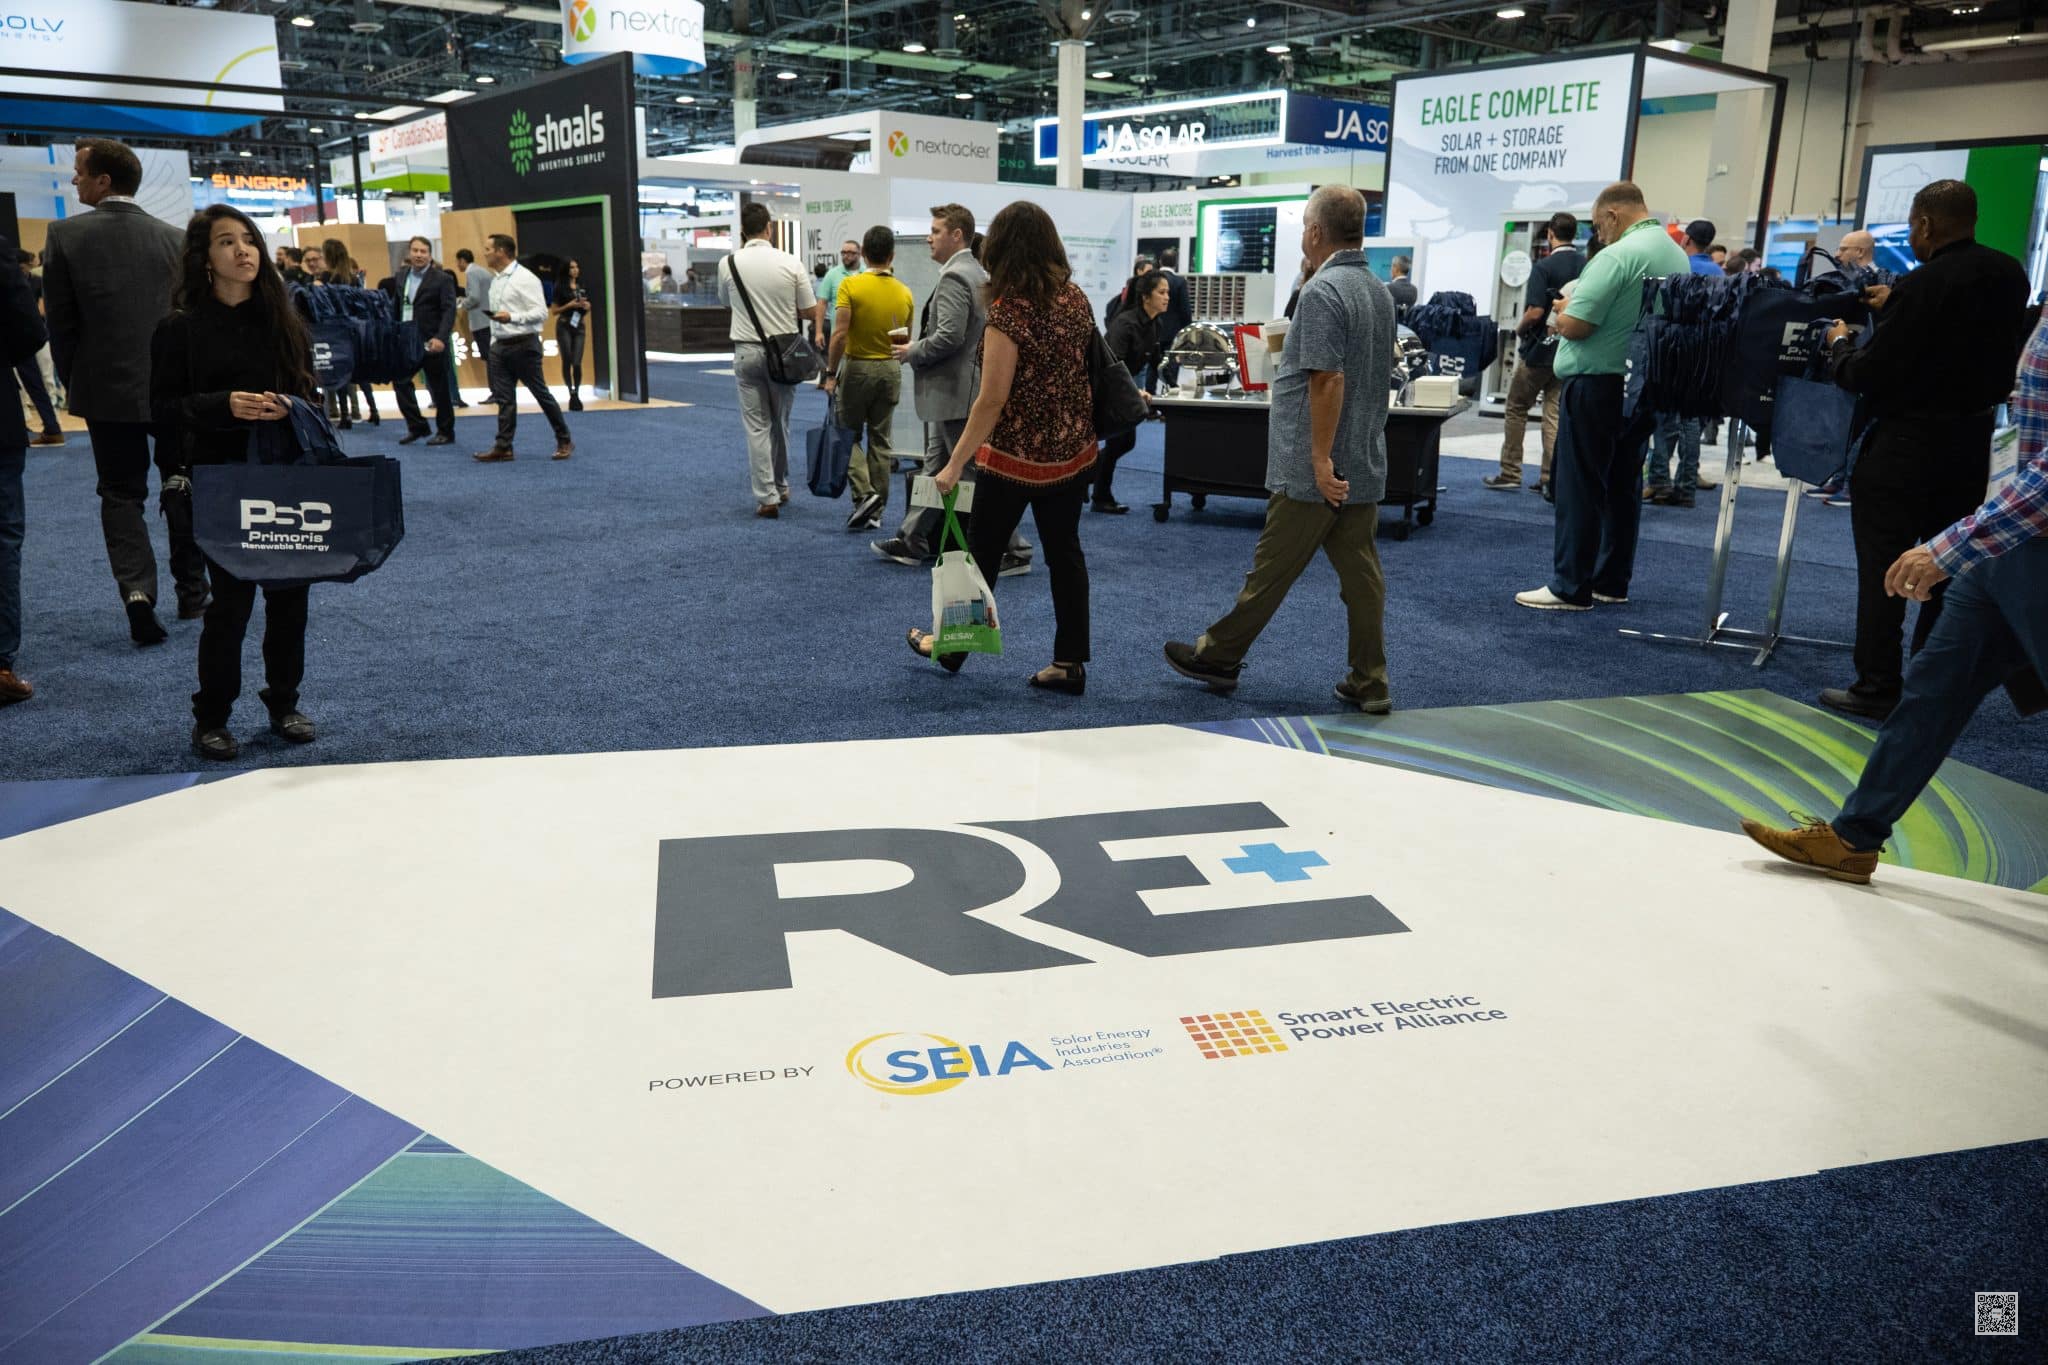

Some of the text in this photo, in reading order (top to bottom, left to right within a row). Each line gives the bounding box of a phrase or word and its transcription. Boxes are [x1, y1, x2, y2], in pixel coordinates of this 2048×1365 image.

[0, 15, 64, 32] OLV
[1421, 81, 1600, 126] EAGLE COMPLETE
[535, 104, 604, 155] shoals
[1324, 108, 1365, 142] JA
[915, 138, 991, 159] nextracker
[1441, 132, 1481, 152] SOLAR
[1502, 125, 1563, 148] STORAGE
[1434, 149, 1567, 175] FROM ONE COMPANY
[211, 173, 307, 191] SUNGROW
[241, 542, 329, 552] Renewable Energy
[248, 531, 324, 543] Primoris
[1278, 994, 1480, 1026] Smart Electric
[1050, 1029, 1151, 1046] Solar Energy
[1290, 1008, 1508, 1041] Power Alliance
[886, 1041, 1054, 1083] SEIA
[1056, 1042, 1131, 1057] Industries
[649, 1065, 814, 1091] POWERED BY
